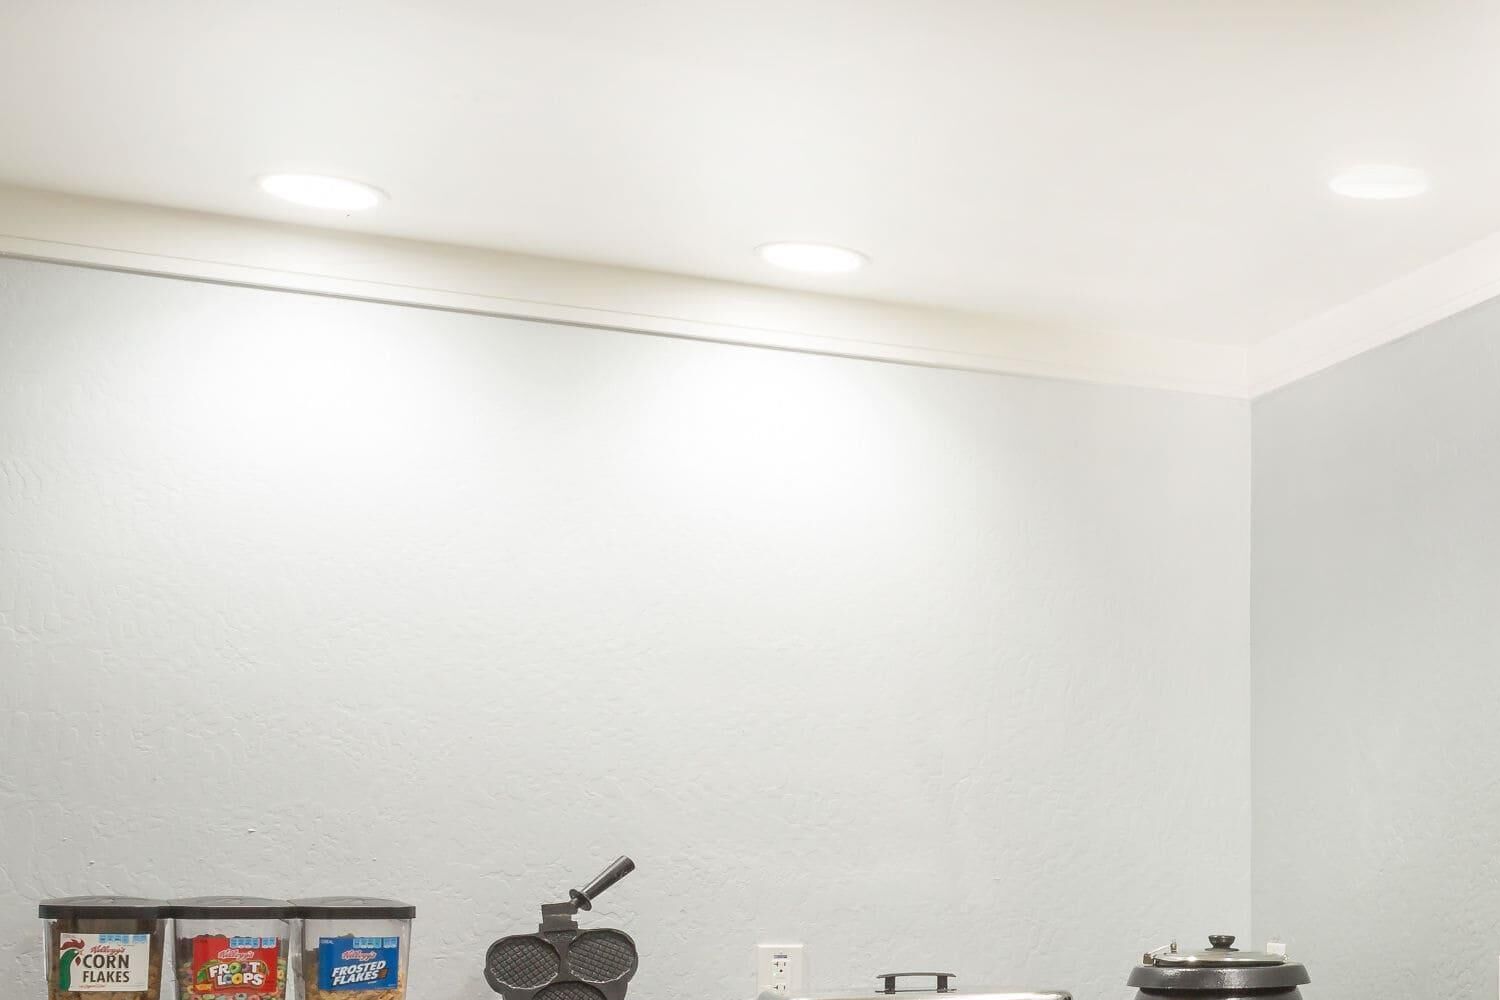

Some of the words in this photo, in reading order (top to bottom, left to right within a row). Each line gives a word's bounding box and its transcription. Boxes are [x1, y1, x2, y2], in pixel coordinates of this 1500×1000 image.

[83, 953, 130, 969] CORN
[331, 960, 387, 977] FROSTED
[83, 970, 130, 983] FLAKES
[217, 972, 265, 986] LOOPS
[332, 970, 379, 986] FLAKES
